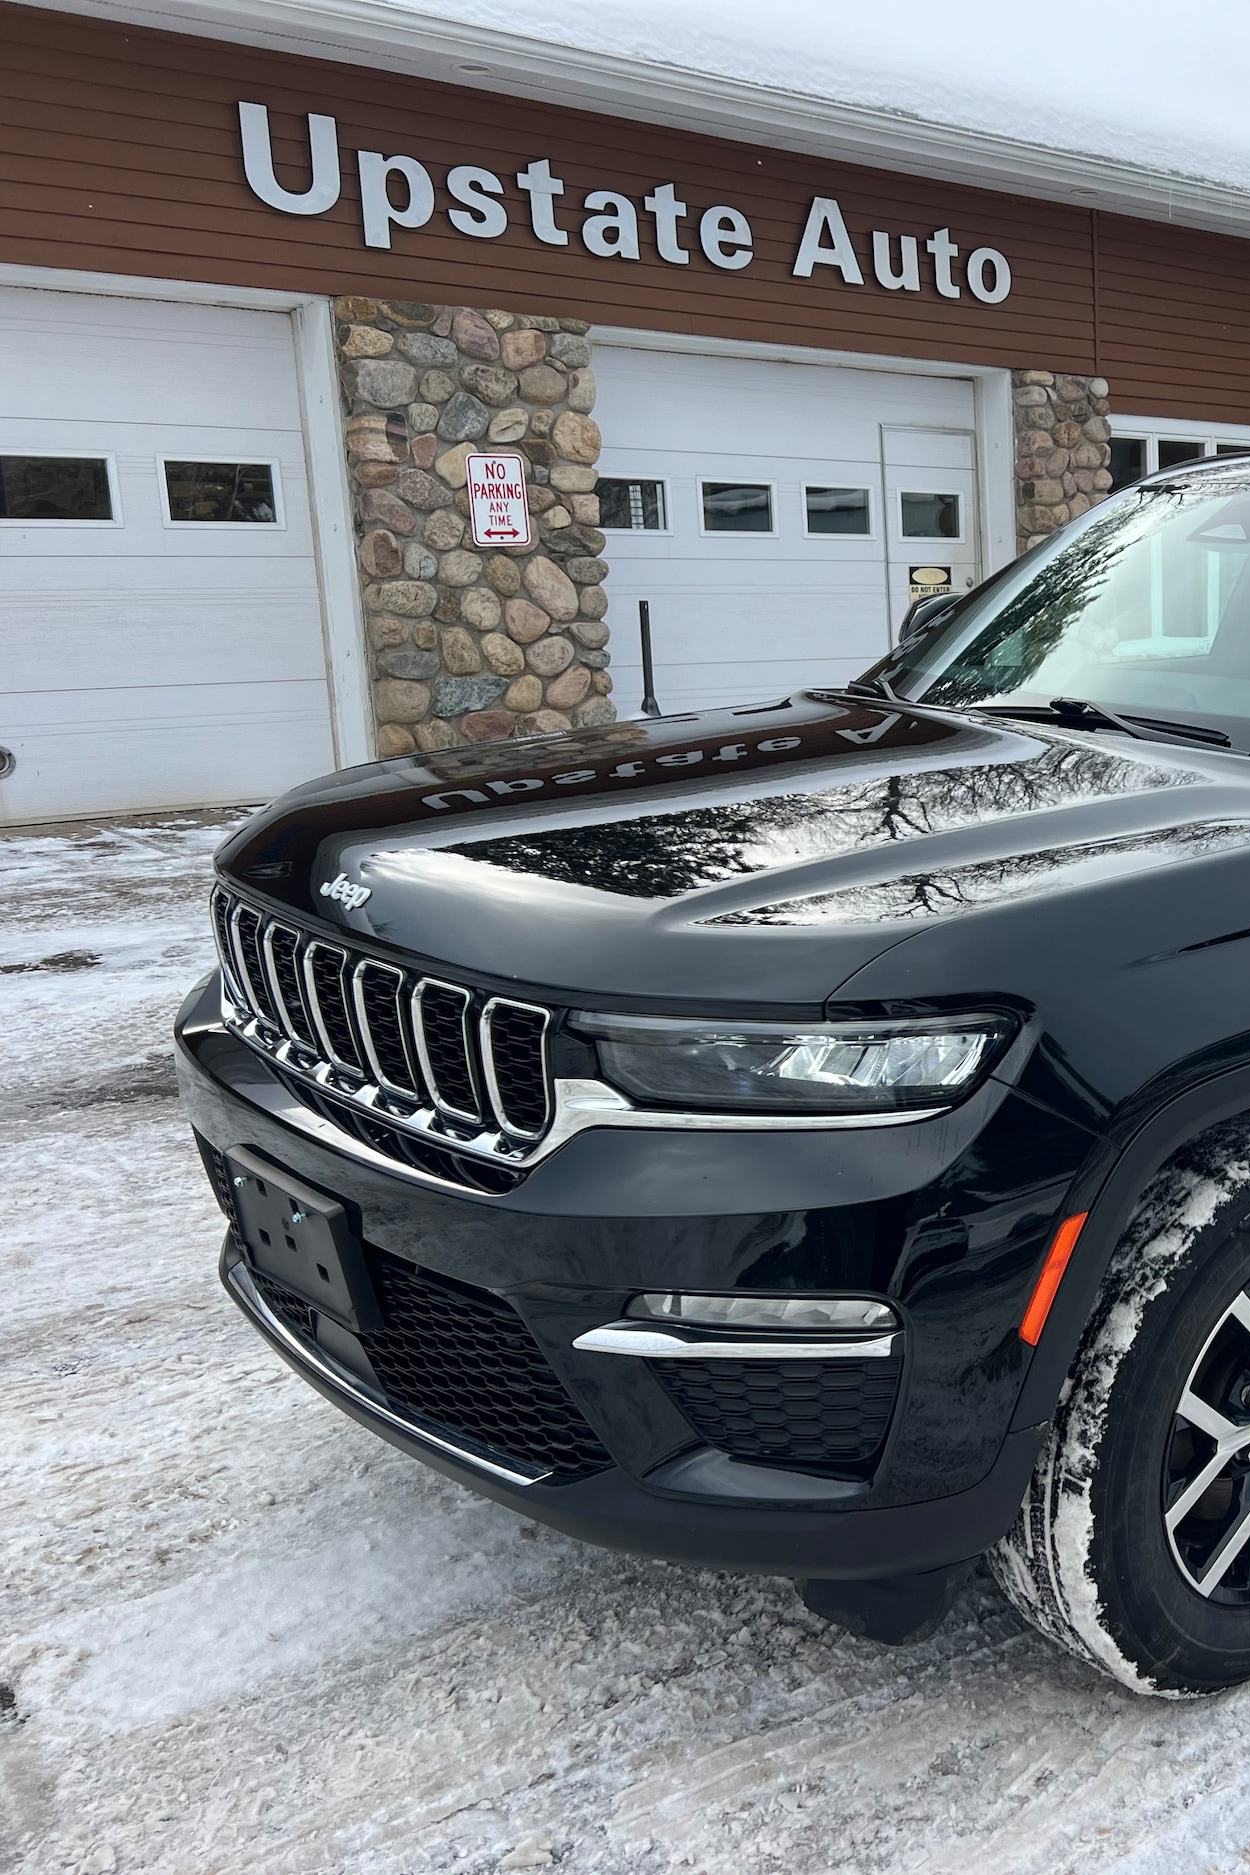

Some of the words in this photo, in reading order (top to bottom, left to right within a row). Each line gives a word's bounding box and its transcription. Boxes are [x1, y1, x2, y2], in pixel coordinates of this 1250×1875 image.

[237, 100, 754, 271] Upstate
[792, 196, 1013, 304] Auto
[485, 463, 506, 479] NO
[473, 483, 522, 499] PARKING
[489, 502, 509, 513] ANY
[488, 515, 513, 526] TIME
[320, 872, 371, 911] Jeep
